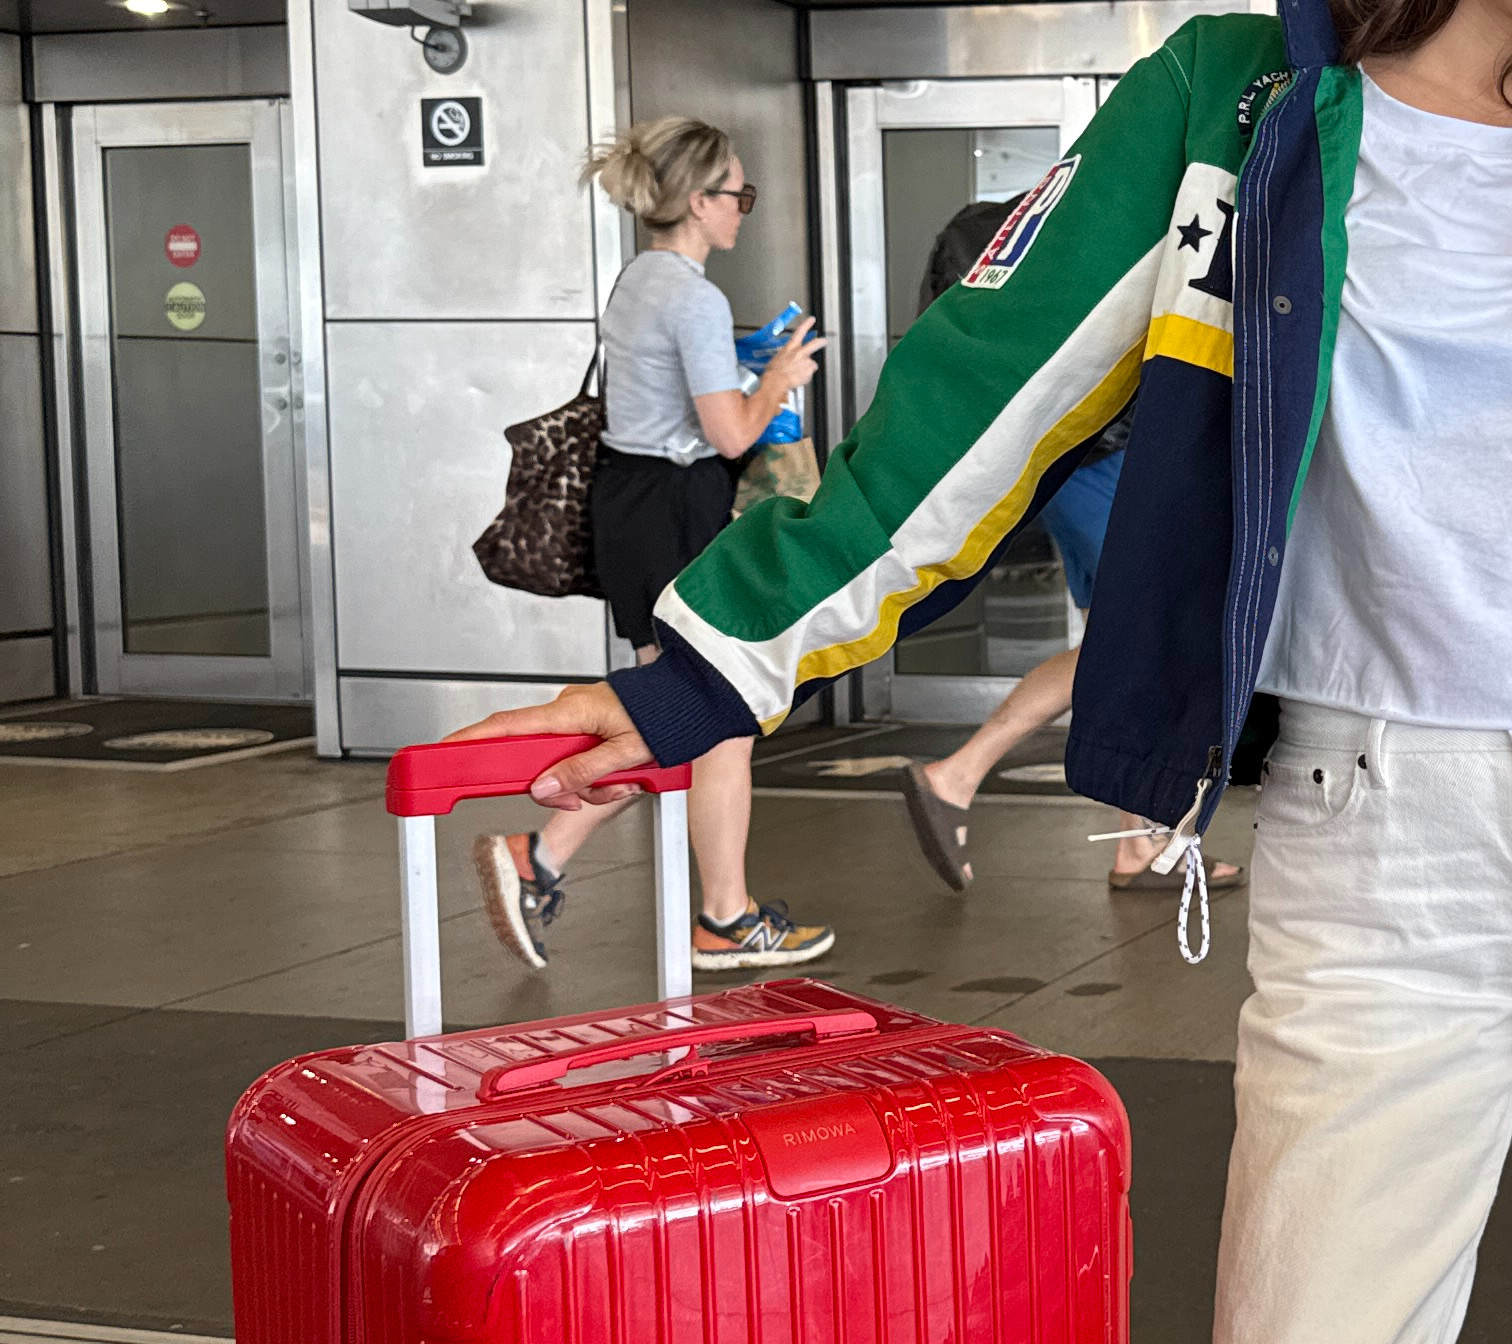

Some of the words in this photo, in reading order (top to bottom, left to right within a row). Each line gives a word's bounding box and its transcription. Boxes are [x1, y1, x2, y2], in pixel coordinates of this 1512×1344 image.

[1252, 70, 1292, 88] YACH
[979, 268, 1009, 285] 1967
[783, 1122, 857, 1147] RIMOWA
